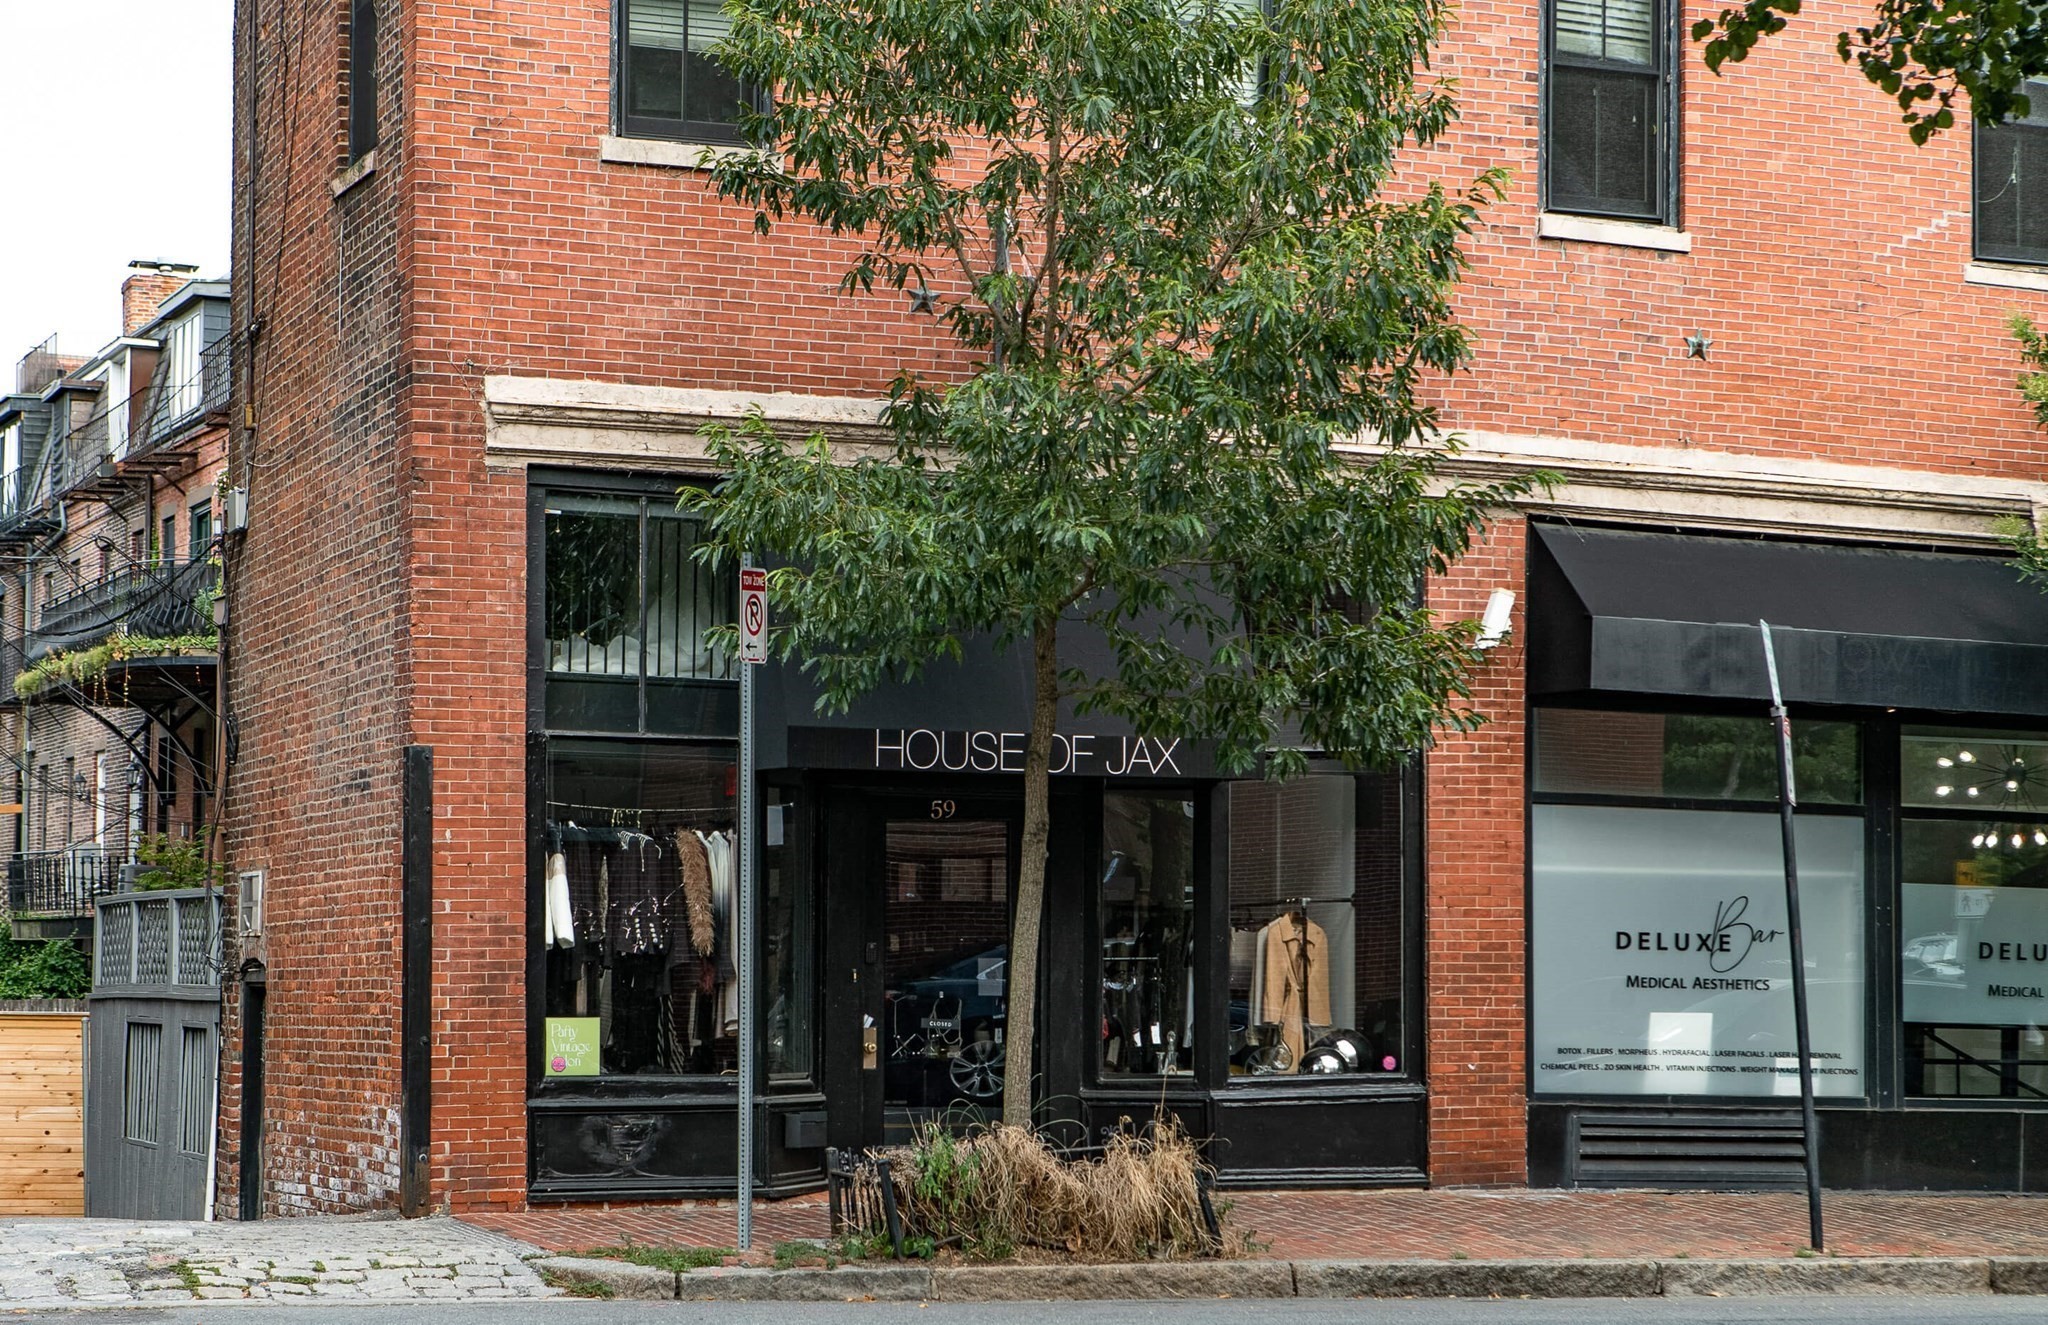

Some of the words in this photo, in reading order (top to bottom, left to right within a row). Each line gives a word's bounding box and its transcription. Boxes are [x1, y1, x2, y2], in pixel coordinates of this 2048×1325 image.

[876, 729, 1025, 772] HOUSE
[1048, 734, 1095, 773] OF
[1106, 736, 1181, 775] JAX
[931, 800, 956, 820] 59
[1616, 932, 1731, 952] DELUXE
[1710, 895, 1785, 973] Bar
[1979, 942, 2048, 961] DELU
[1626, 975, 1687, 989] MEDICAL
[1692, 977, 1770, 990] AESTHETICS
[1988, 984, 2045, 998] MEDICAL
[551, 1053, 581, 1067] lon
[1618, 1048, 1658, 1056] MORPHEUS
[1662, 1049, 1710, 1057] HYDRAFACIAL
[1737, 1050, 1765, 1058] FACIALS
[1578, 1063, 1600, 1071] PEELS
[1696, 1065, 1736, 1073] INJECTIONS
